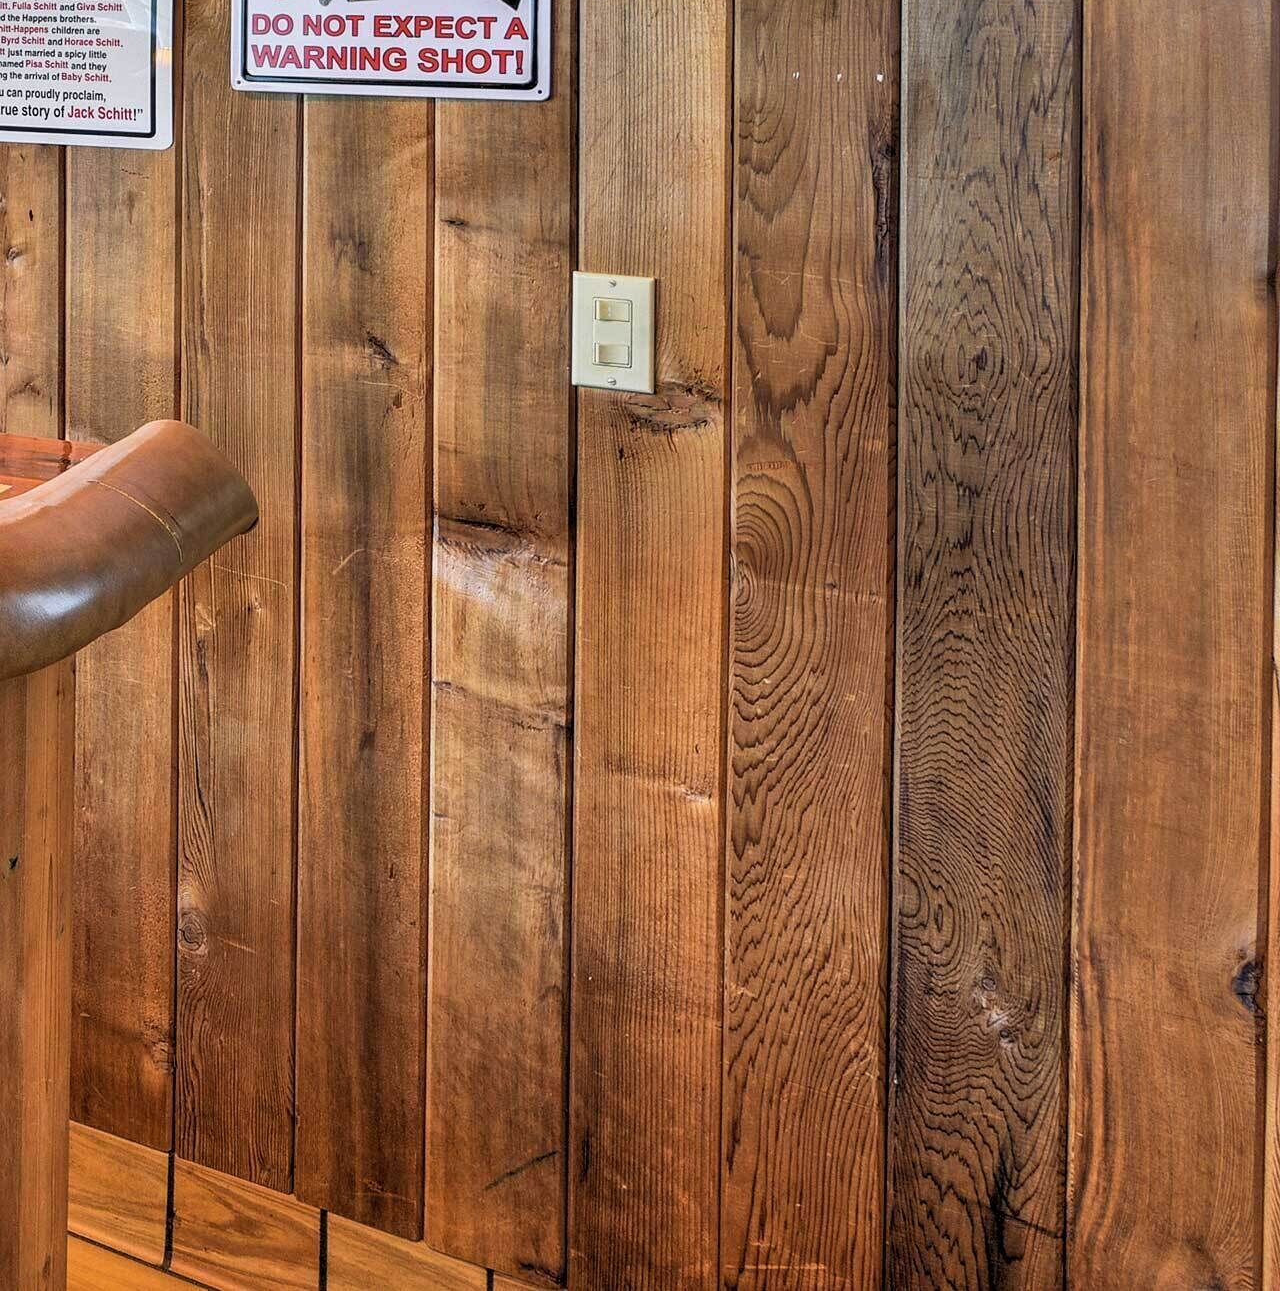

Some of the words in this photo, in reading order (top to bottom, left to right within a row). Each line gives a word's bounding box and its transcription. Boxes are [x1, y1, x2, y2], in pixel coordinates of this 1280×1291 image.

[21, 15, 57, 23] Happens
[59, 15, 96, 23] brothers.
[49, 25, 84, 34] children
[252, 13, 293, 37] DO
[302, 15, 365, 37] NOT
[374, 15, 498, 39] EXPECT
[504, 17, 529, 40] A
[6, 47, 22, 58] just
[24, 48, 55, 57] married
[64, 49, 86, 60] spicy
[88, 50, 107, 58] little
[251, 45, 408, 71] WARNING
[417, 49, 524, 76] SHOT!
[9, 71, 22, 79] the
[24, 71, 49, 80] arrival
[50, 72, 59, 80] of
[60, 72, 83, 83] Baby
[84, 73, 111, 82] Schitt.
[5, 89, 23, 97] can
[24, 87, 61, 101] proudly
[61, 88, 106, 103] proclaim,
[20, 103, 52, 120] story
[53, 104, 65, 117] of
[65, 105, 96, 118] Jack
